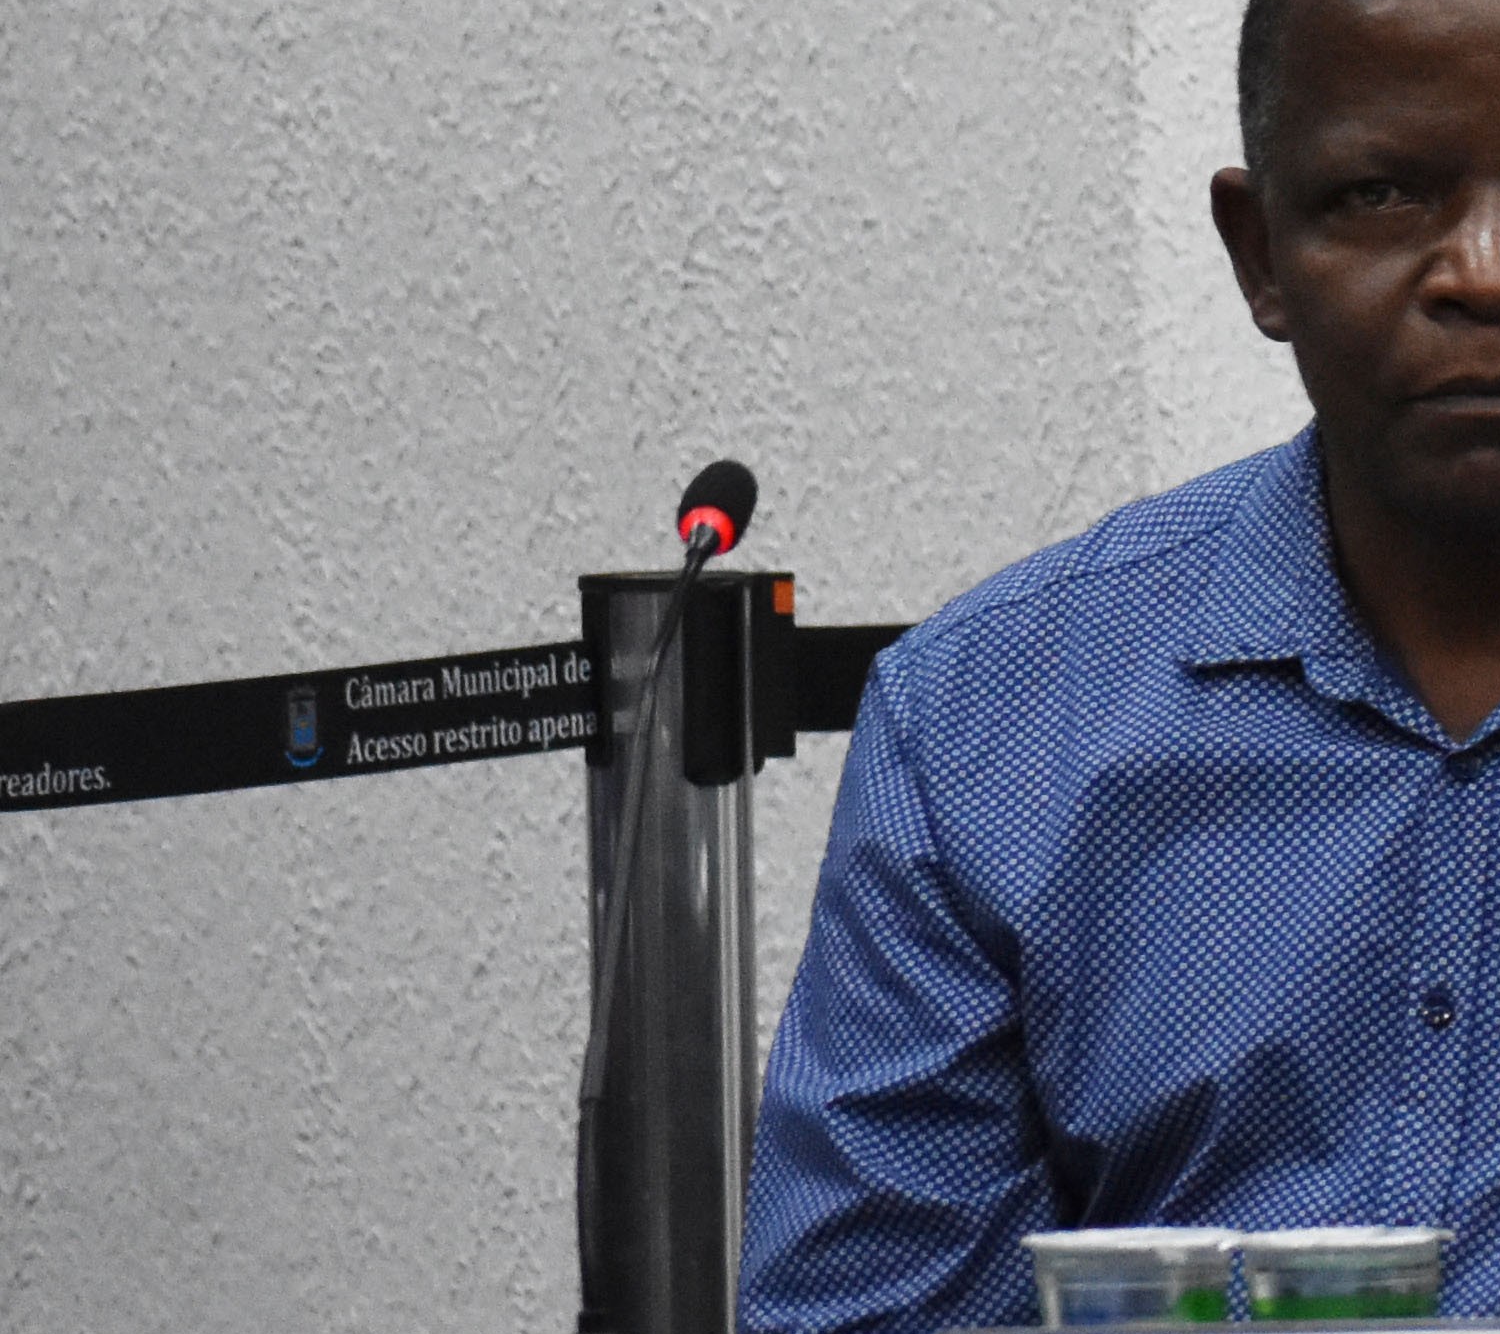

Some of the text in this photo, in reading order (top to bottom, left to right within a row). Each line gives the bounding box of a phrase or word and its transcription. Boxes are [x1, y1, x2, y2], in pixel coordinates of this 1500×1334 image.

[344, 651, 592, 710] Câmara Municipal de
[347, 731, 427, 764] Acesso
[433, 716, 522, 754] restrito
